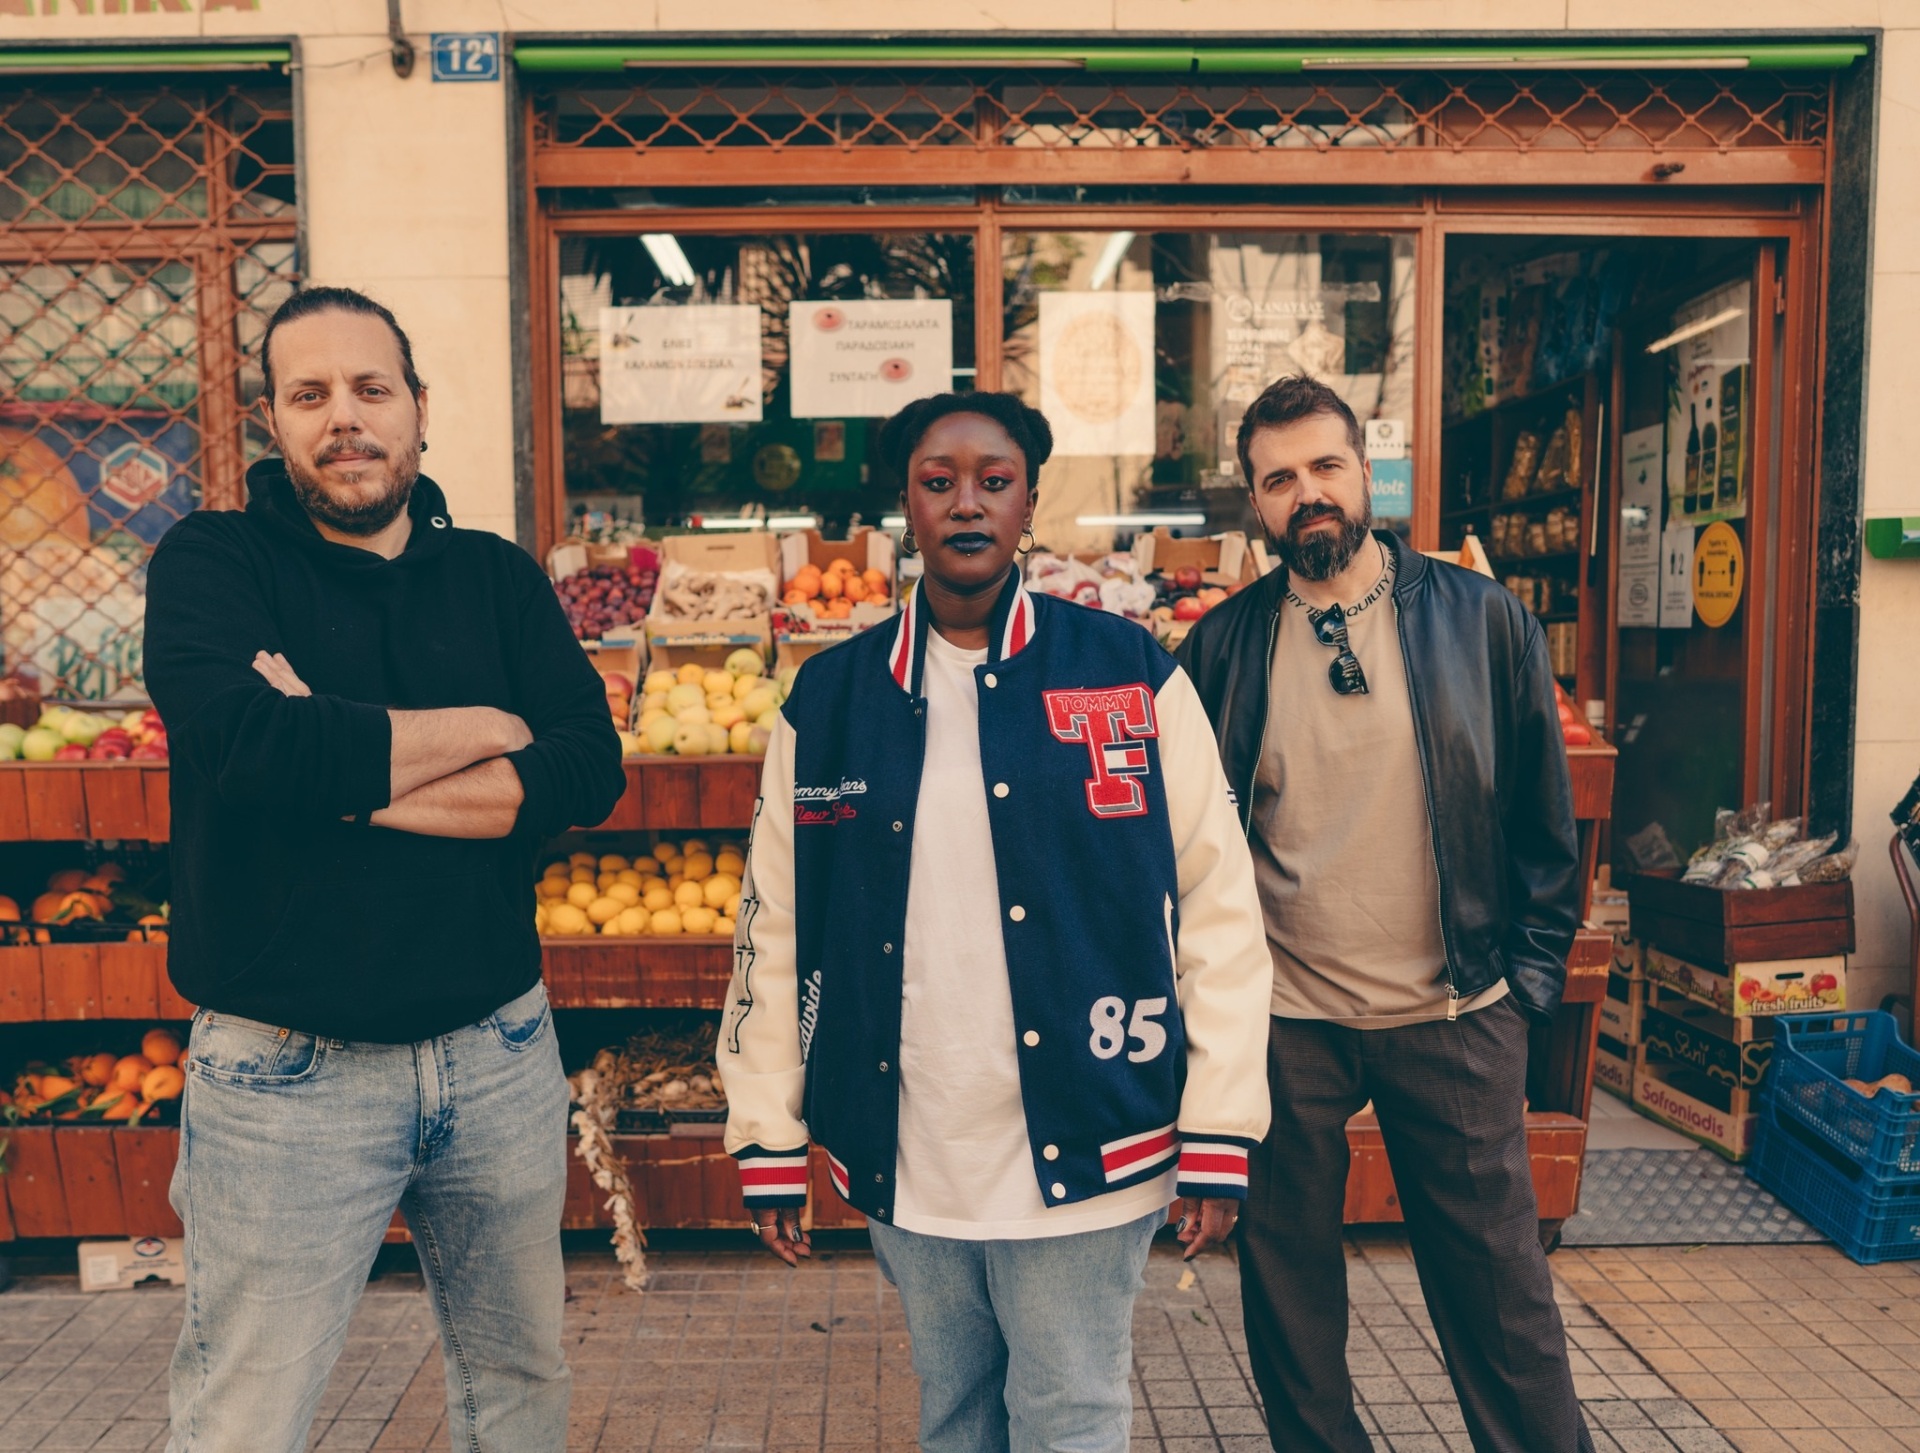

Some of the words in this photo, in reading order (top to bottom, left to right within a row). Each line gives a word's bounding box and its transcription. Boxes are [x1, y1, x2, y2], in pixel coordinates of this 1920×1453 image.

[1057, 692, 1133, 713] TOMMY
[1752, 998, 1785, 1013] fresh
[1789, 994, 1825, 1010] fruits
[1089, 996, 1167, 1063] 85
[1642, 1082, 1724, 1138] Sofroniadis
